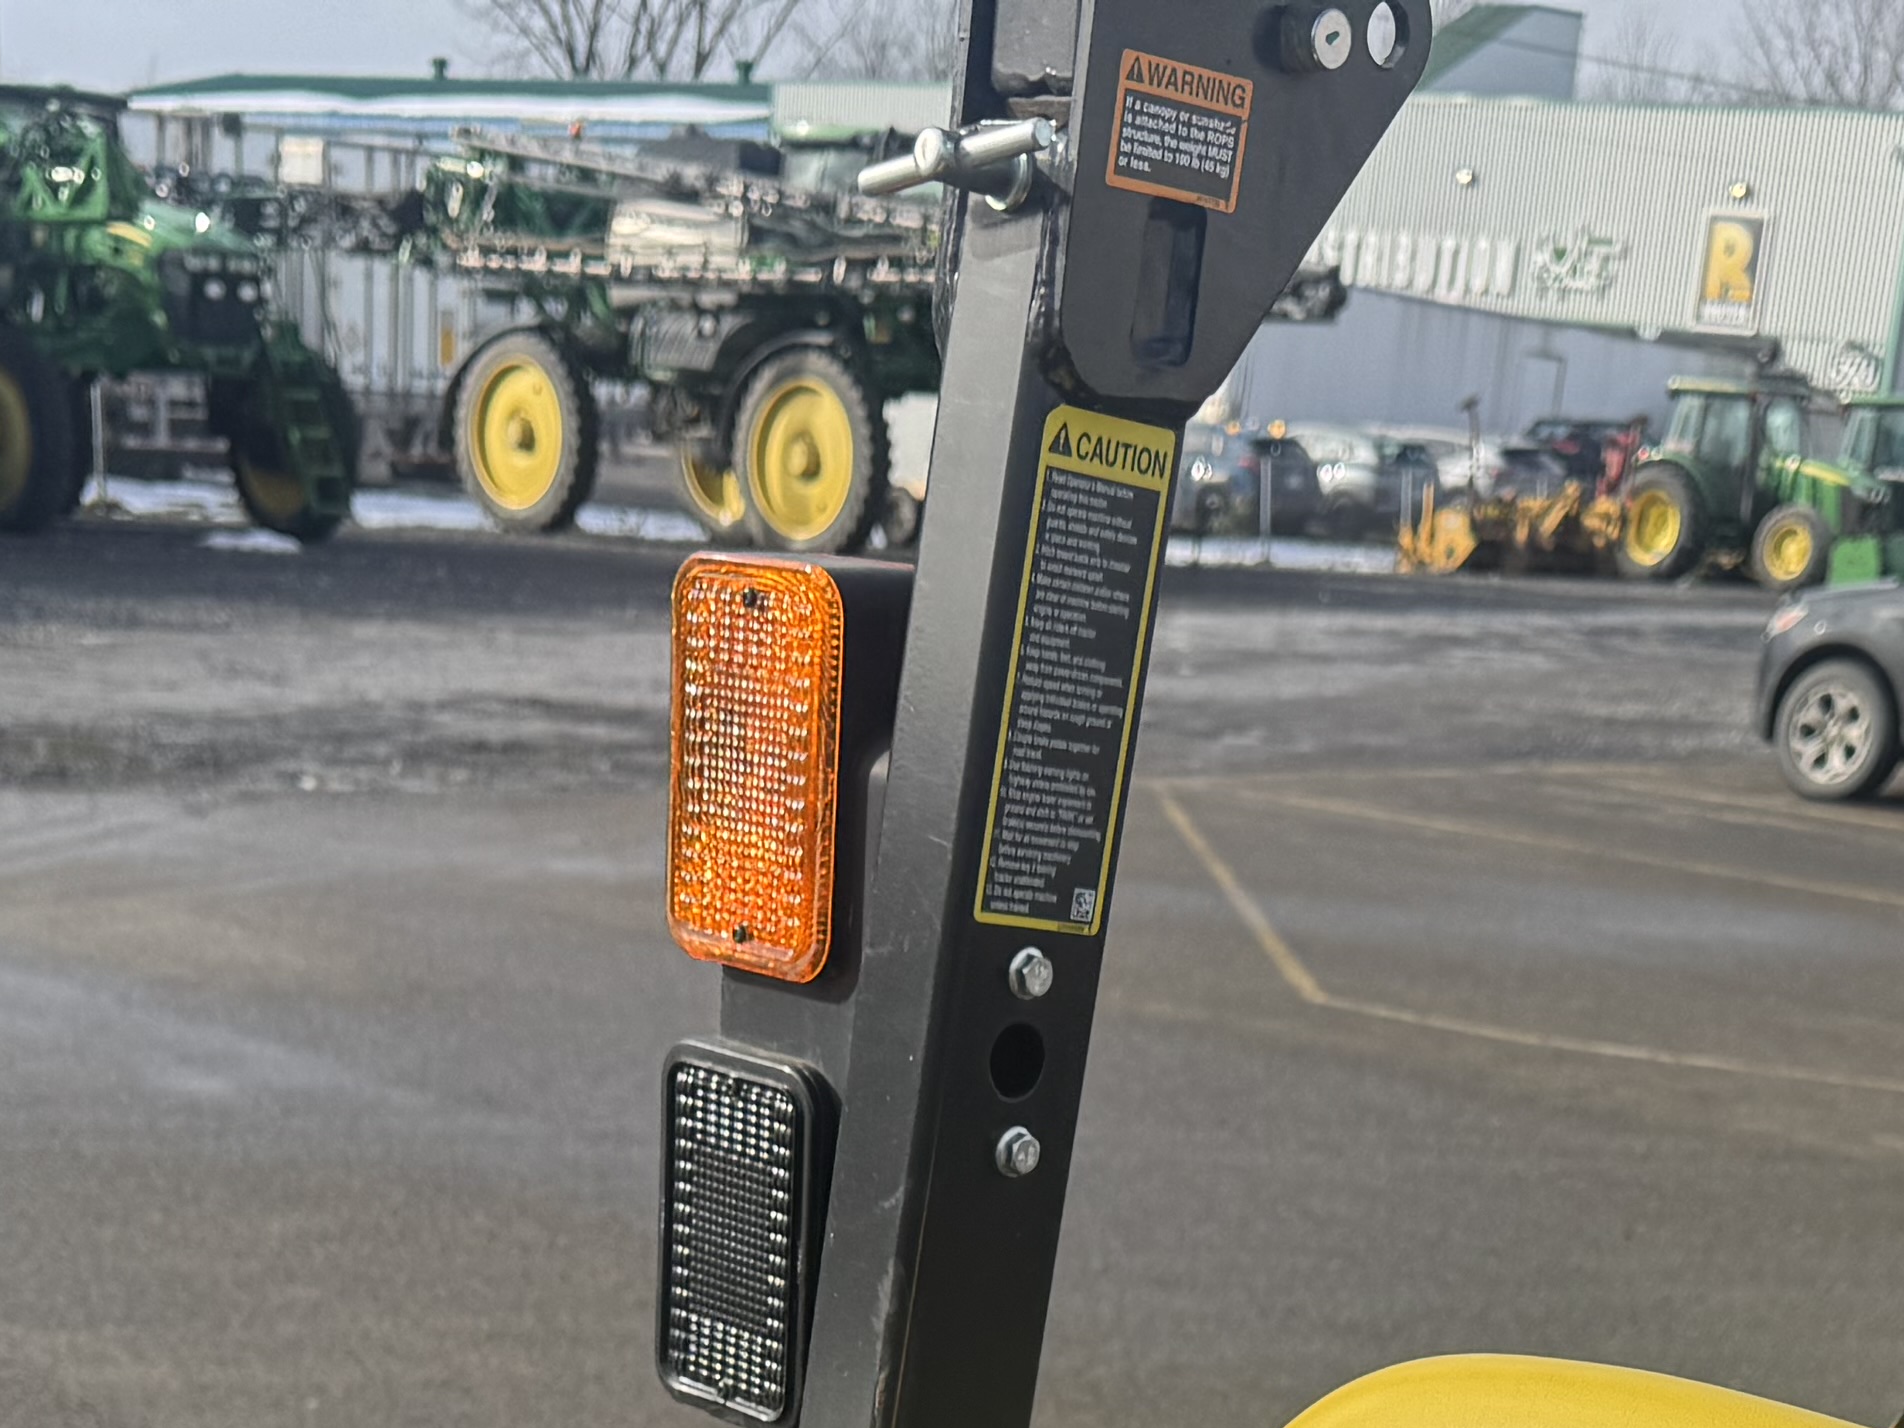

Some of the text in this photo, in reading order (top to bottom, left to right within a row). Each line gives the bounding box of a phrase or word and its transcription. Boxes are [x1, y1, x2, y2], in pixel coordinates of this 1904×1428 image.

[1148, 60, 1246, 109] WARNING
[1135, 115, 1176, 134] attached
[1207, 131, 1234, 148] ROPS
[1208, 145, 1233, 163] MUST
[1075, 431, 1167, 479] CAUTION
